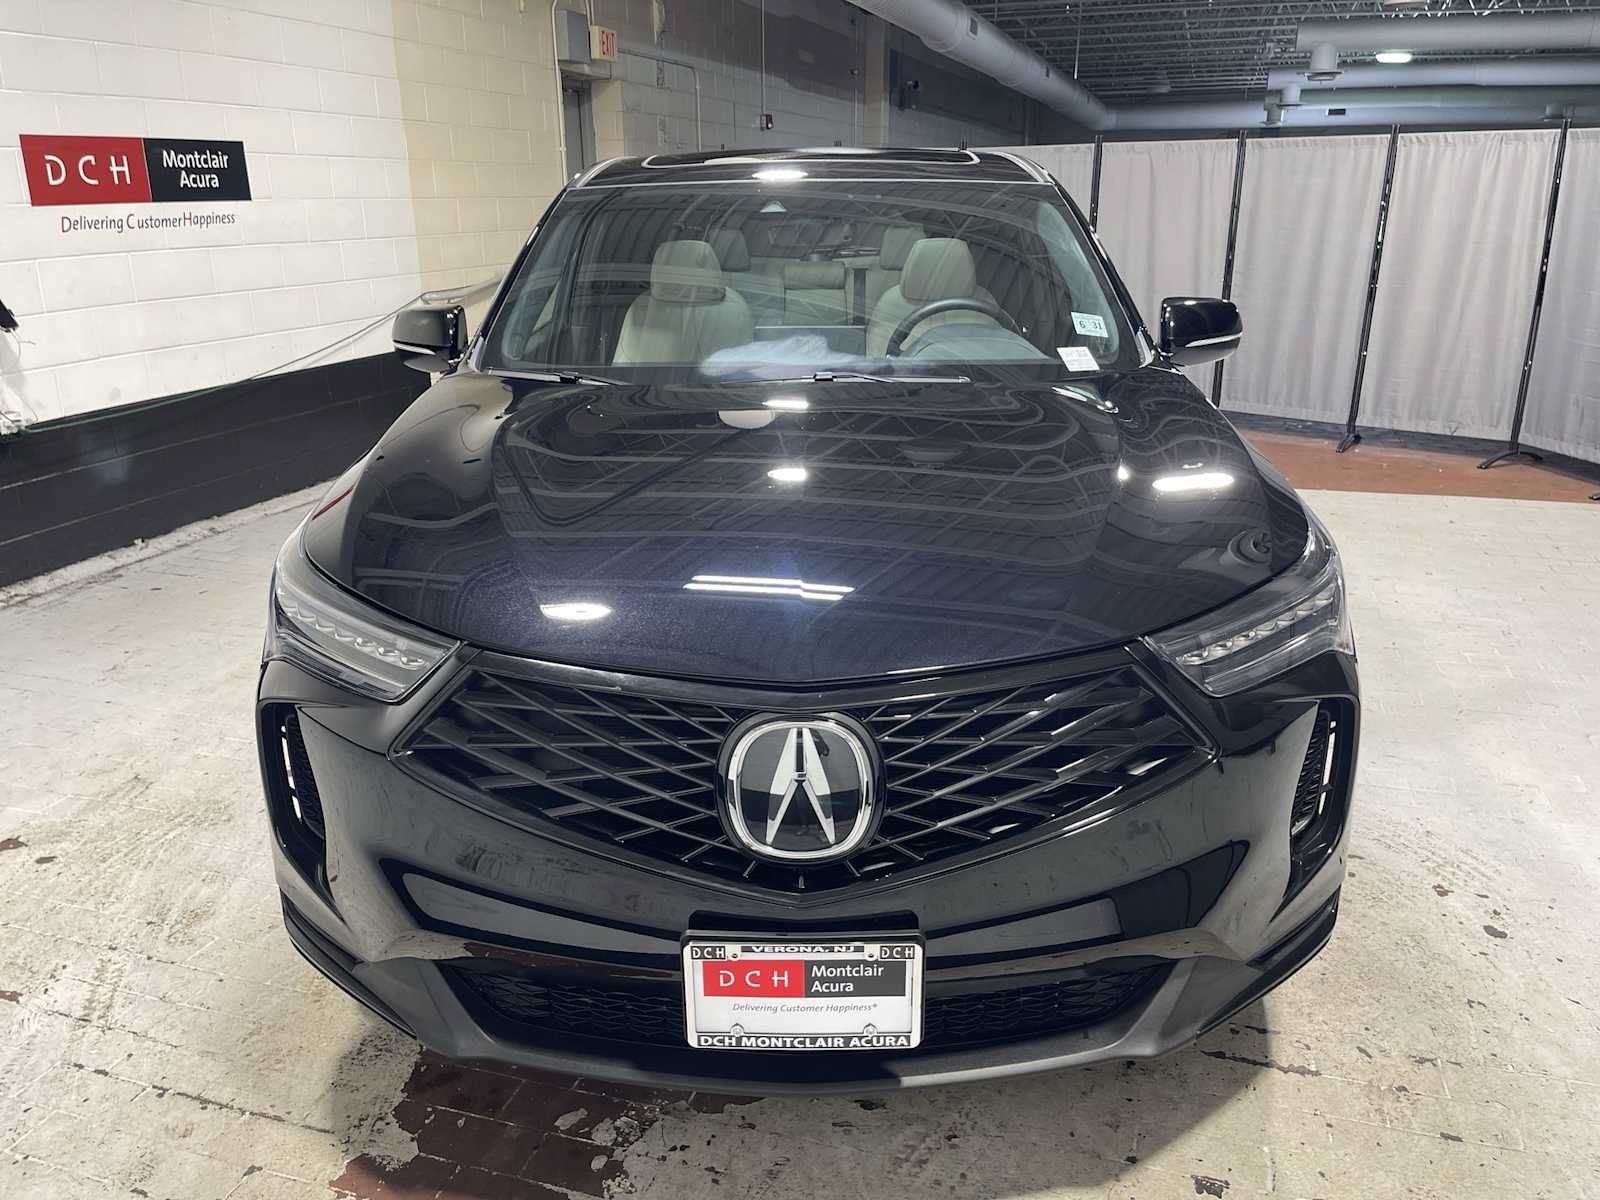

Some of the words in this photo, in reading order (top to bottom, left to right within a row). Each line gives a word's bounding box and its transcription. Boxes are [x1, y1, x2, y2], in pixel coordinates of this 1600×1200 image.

[601, 30, 616, 57] EXIT
[162, 150, 229, 169] Montclair
[180, 171, 220, 188] Acura
[61, 215, 124, 234] Delivering
[834, 945, 855, 953] NJ
[811, 965, 884, 977] Montclair
[811, 980, 854, 993] Acura
[732, 1002, 778, 1014] Delivering
[780, 1002, 824, 1013] Customer
[700, 1036, 737, 1047] DCH
[741, 1036, 845, 1048] MONTCLAIR
[849, 1035, 908, 1048] ACURA
